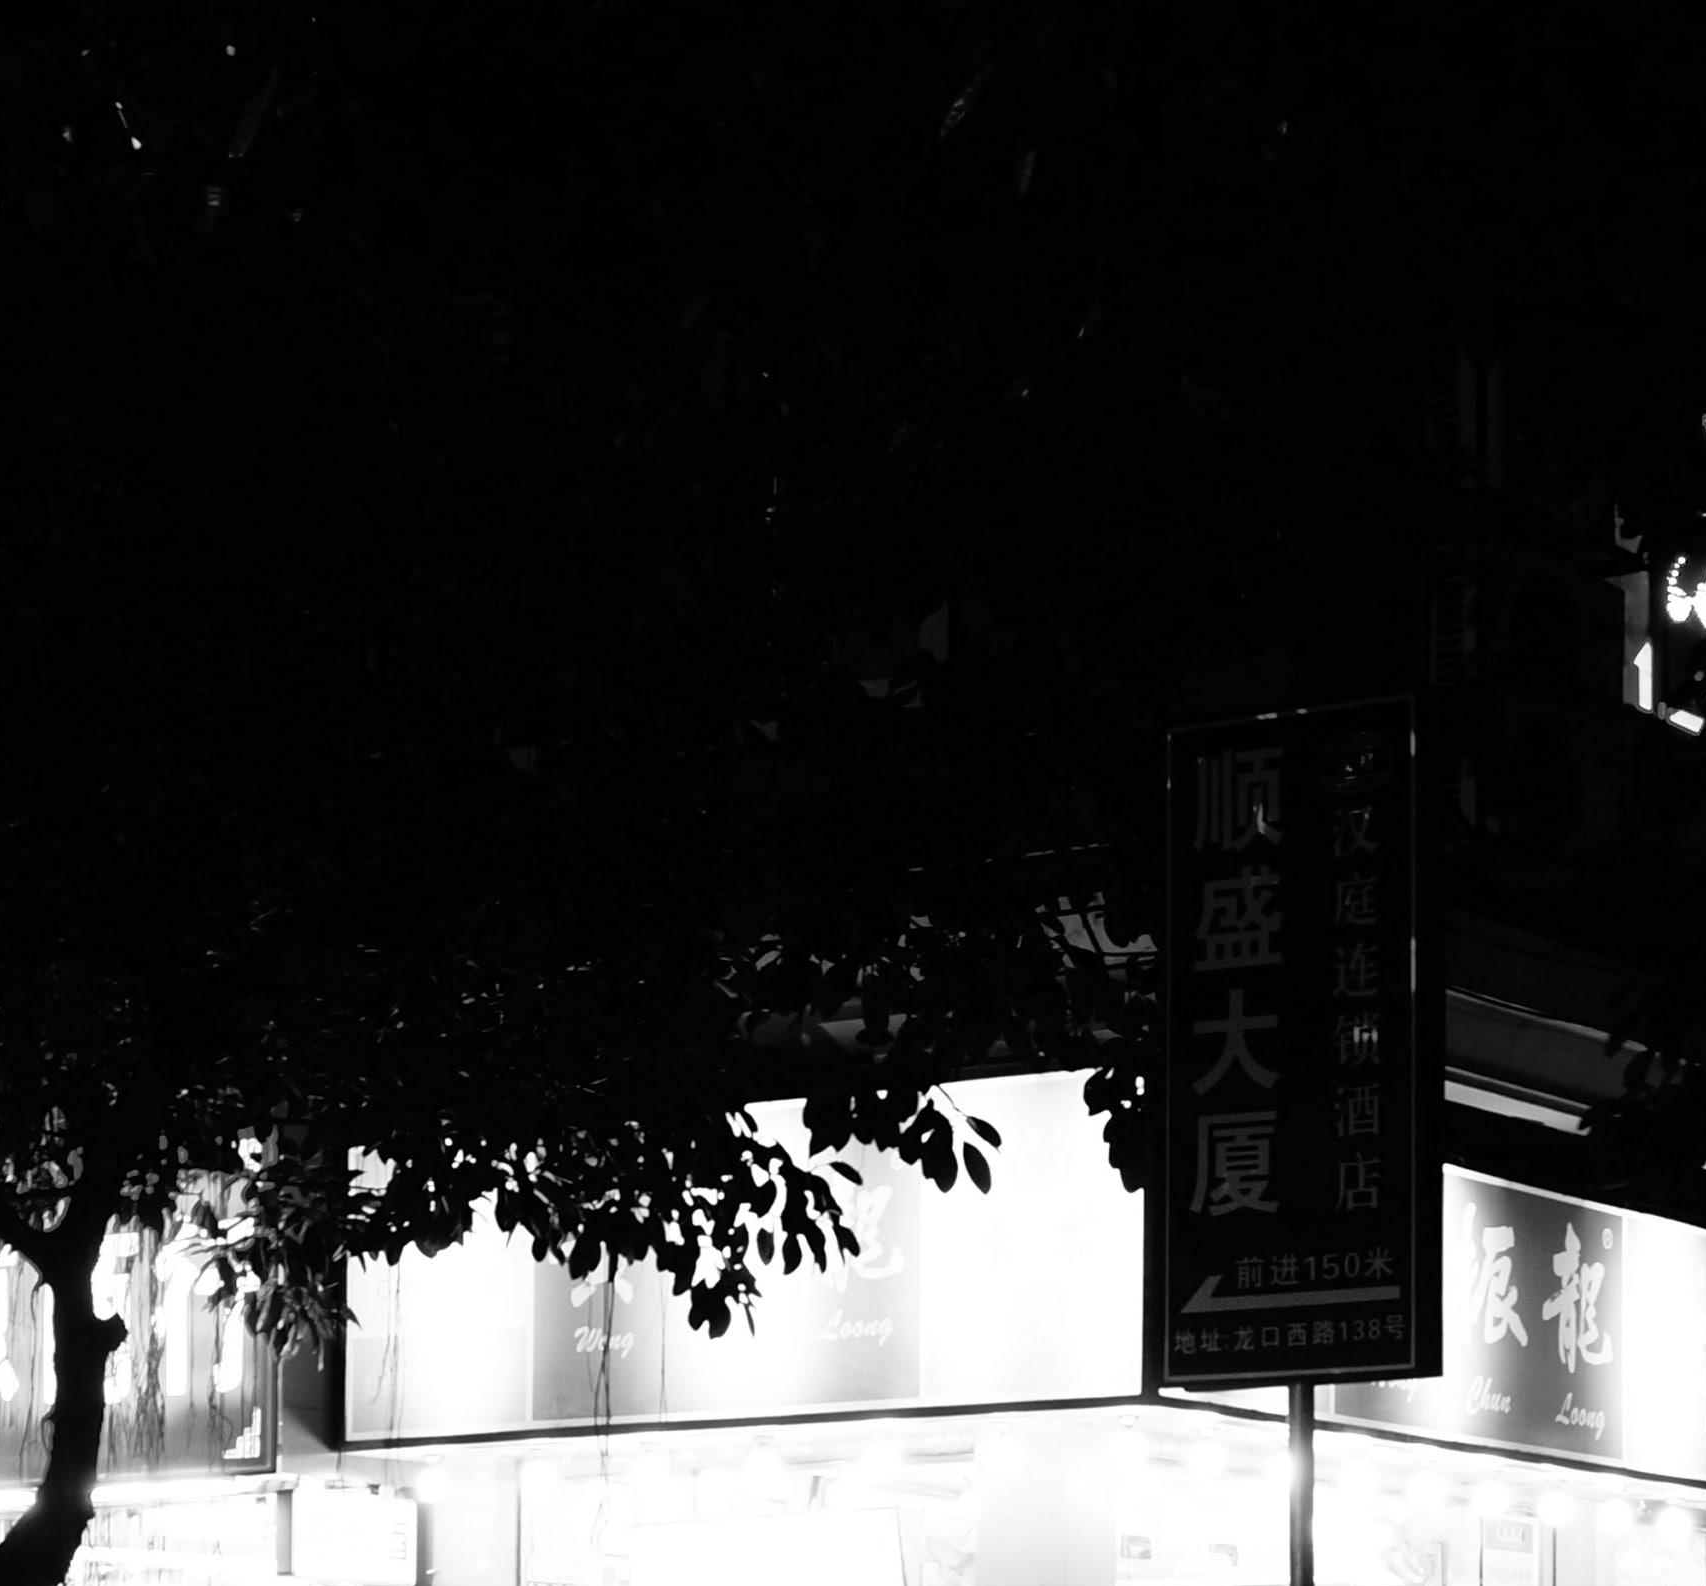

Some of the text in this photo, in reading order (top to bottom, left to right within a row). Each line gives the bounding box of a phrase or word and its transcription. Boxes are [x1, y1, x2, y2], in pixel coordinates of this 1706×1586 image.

[1189, 745, 1286, 1217] 顺盛大厦
[1332, 804, 1382, 1212] 汉庭连锁酒店
[1235, 1246, 1394, 1290] 前进150米
[817, 1310, 895, 1347] Loong
[1466, 1375, 1512, 1416] Chun
[1555, 1392, 1606, 1441] Loong
